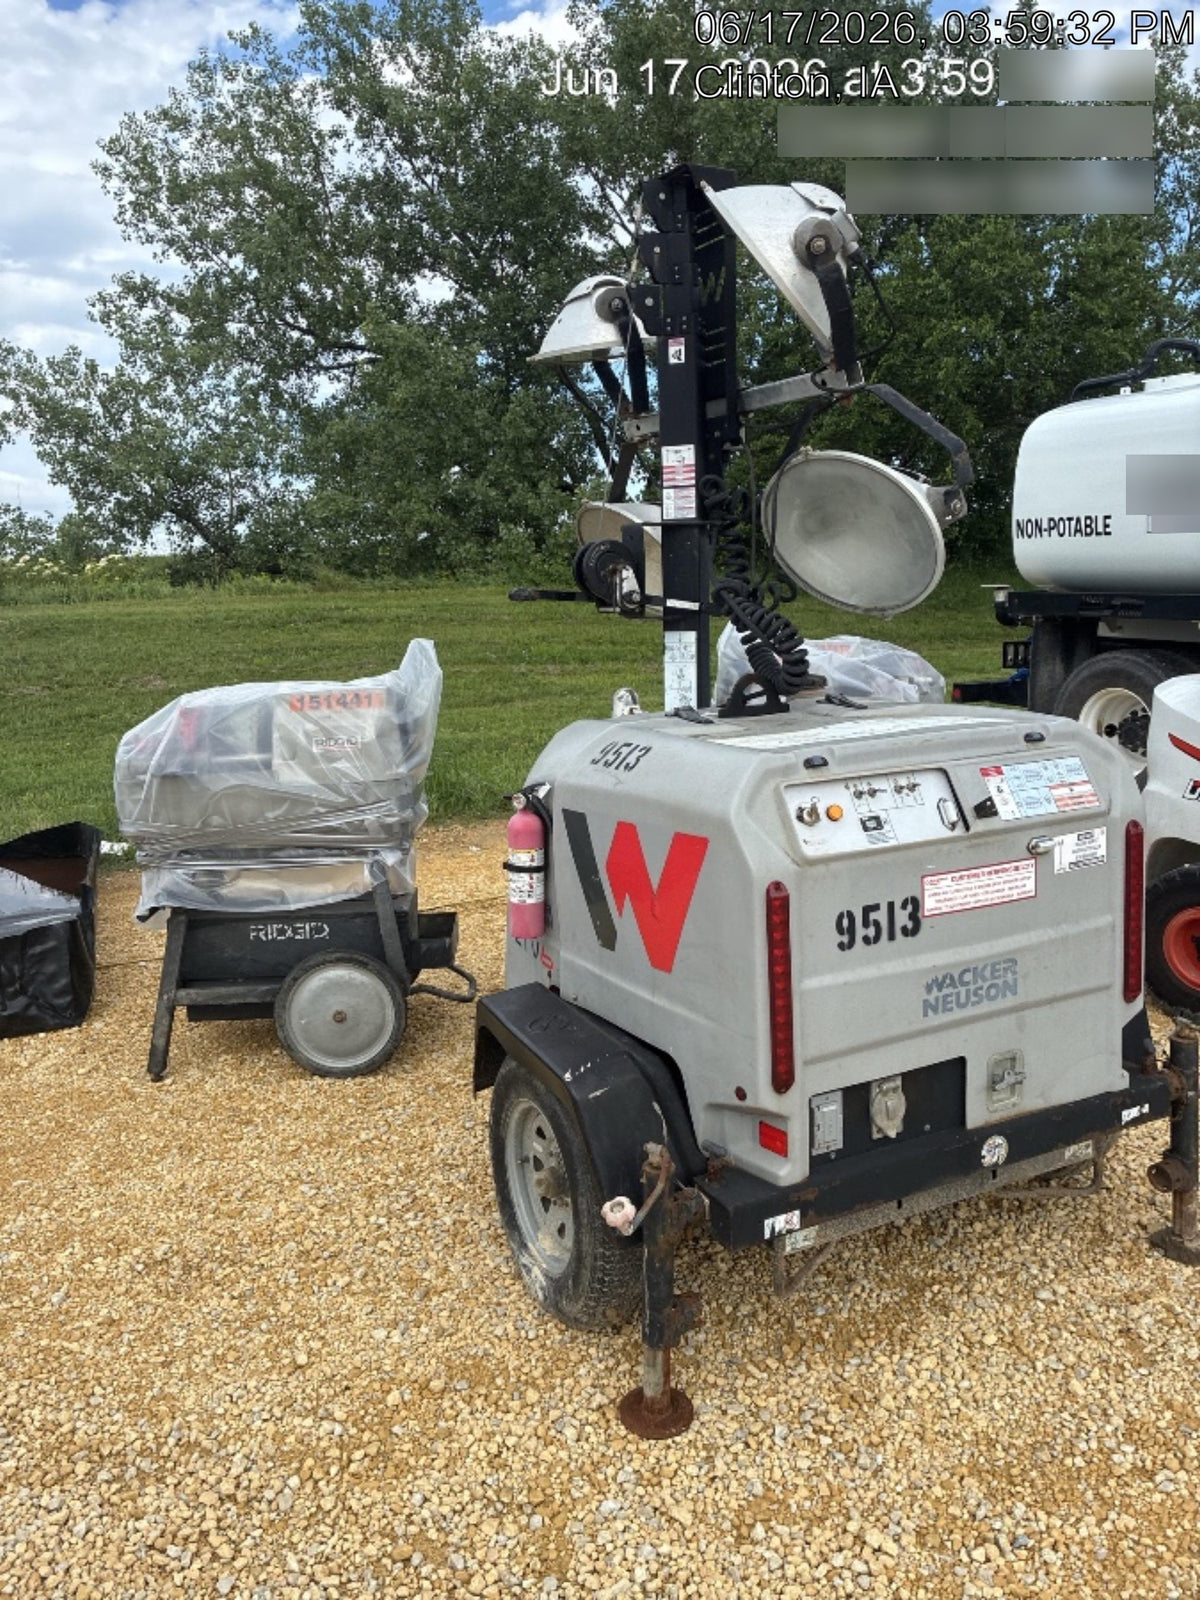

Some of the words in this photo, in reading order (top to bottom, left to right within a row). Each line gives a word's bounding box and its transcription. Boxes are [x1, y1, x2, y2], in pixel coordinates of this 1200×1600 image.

[1015, 515, 1112, 539] NON-POTABLE
[590, 741, 652, 772] 9513
[249, 922, 330, 941] RIDGID
[835, 895, 921, 952] 9513
[924, 958, 1018, 995] WACKER
[922, 977, 1018, 1018] NEUSON
